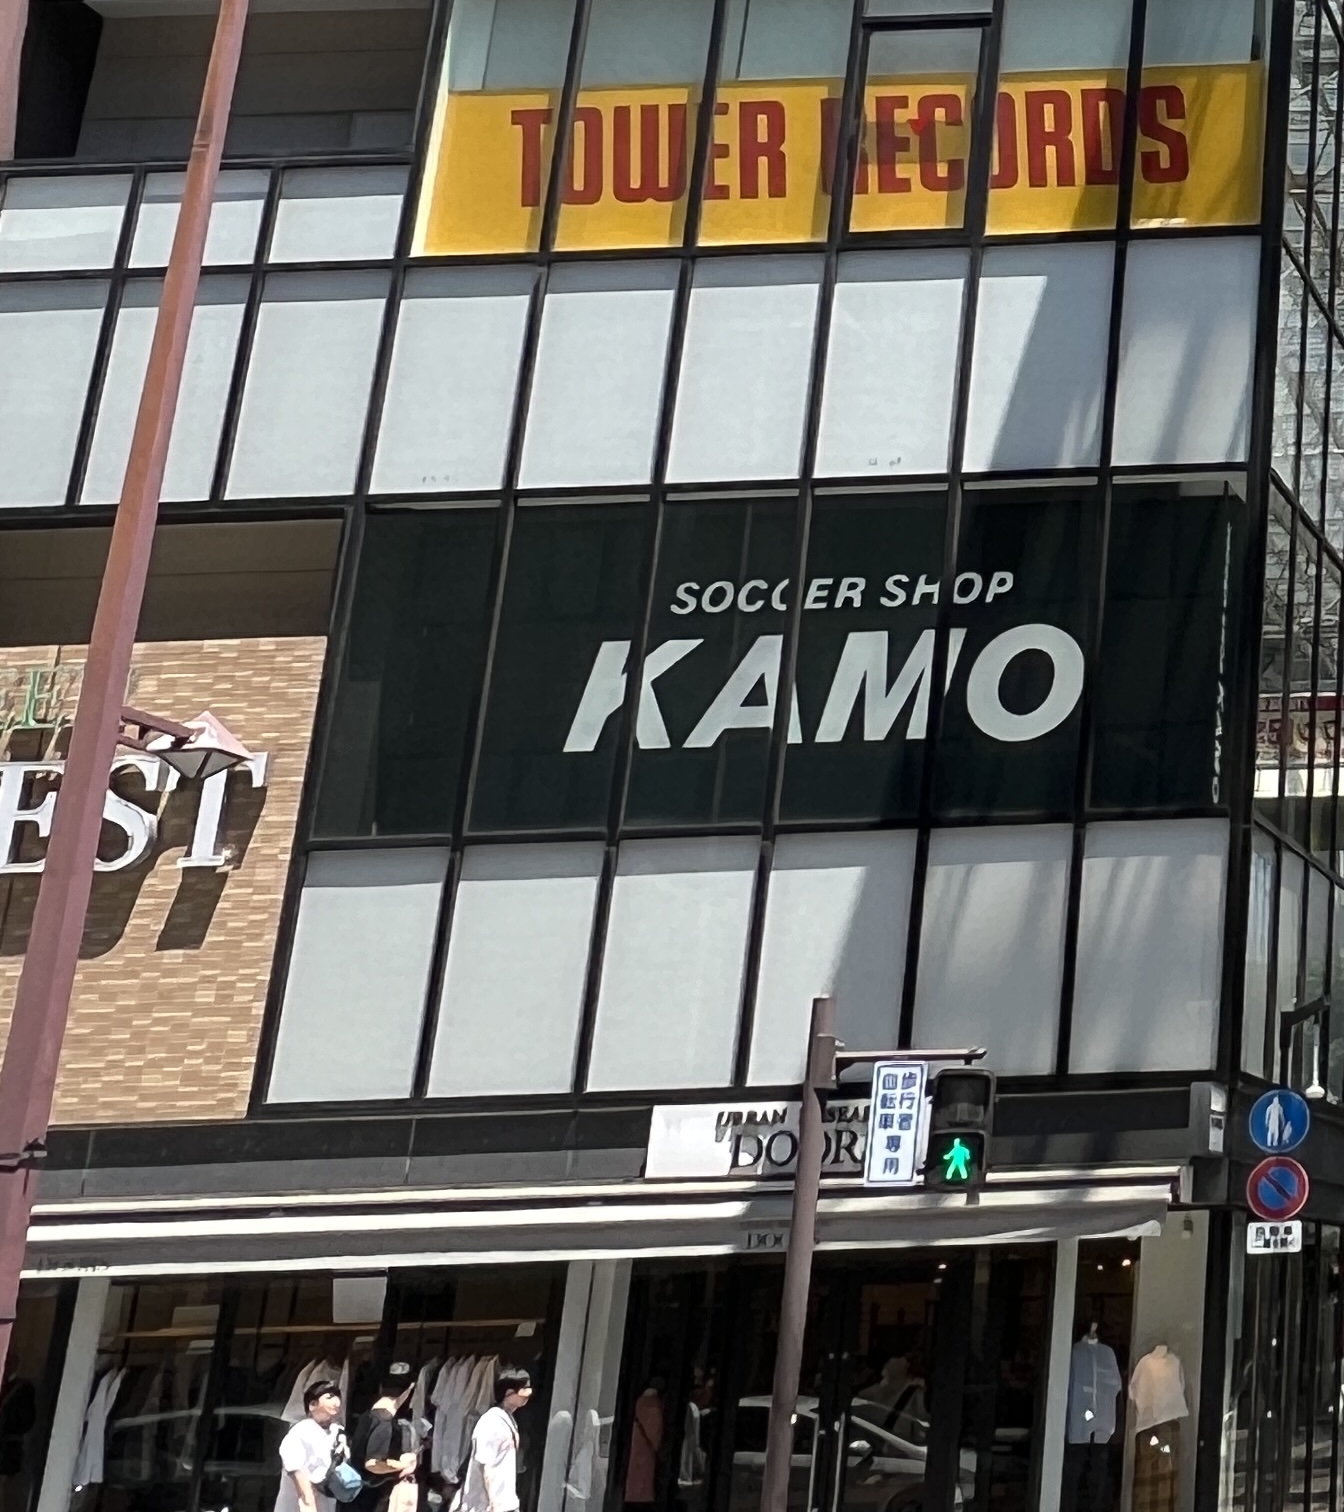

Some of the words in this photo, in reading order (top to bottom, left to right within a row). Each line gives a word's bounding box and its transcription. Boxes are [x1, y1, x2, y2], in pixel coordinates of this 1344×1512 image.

[510, 100, 787, 208] TOWER
[820, 84, 1188, 196] RECORDS
[670, 576, 867, 615] SOCCER
[880, 571, 1014, 608] SHOP
[563, 623, 1085, 753] KAMO
[731, 1130, 867, 1169] DOR
